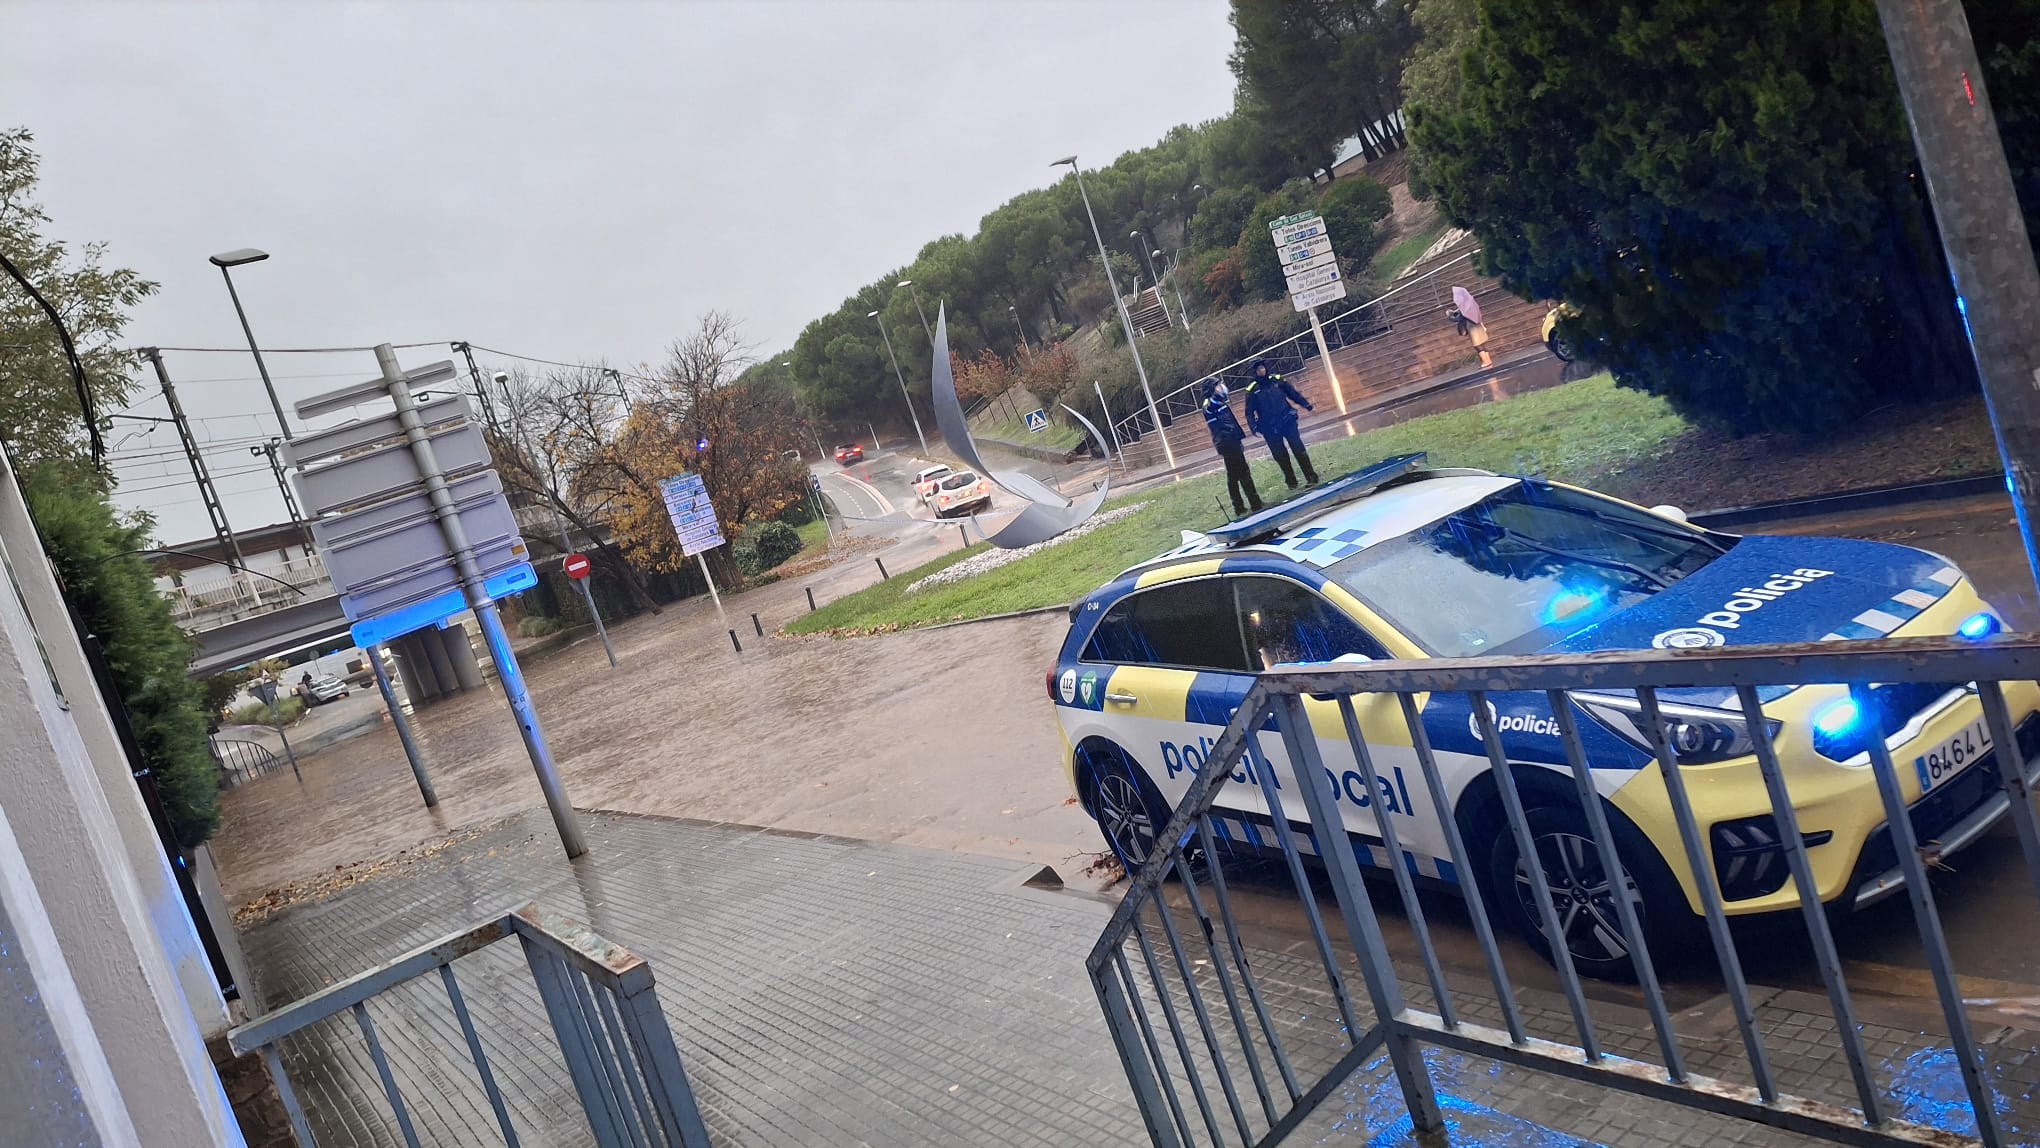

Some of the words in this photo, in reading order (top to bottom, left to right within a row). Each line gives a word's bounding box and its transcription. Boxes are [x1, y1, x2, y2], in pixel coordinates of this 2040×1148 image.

[1696, 568, 1835, 629] policia
[1063, 678, 1073, 689] 112
[1928, 731, 1976, 779] 8464
